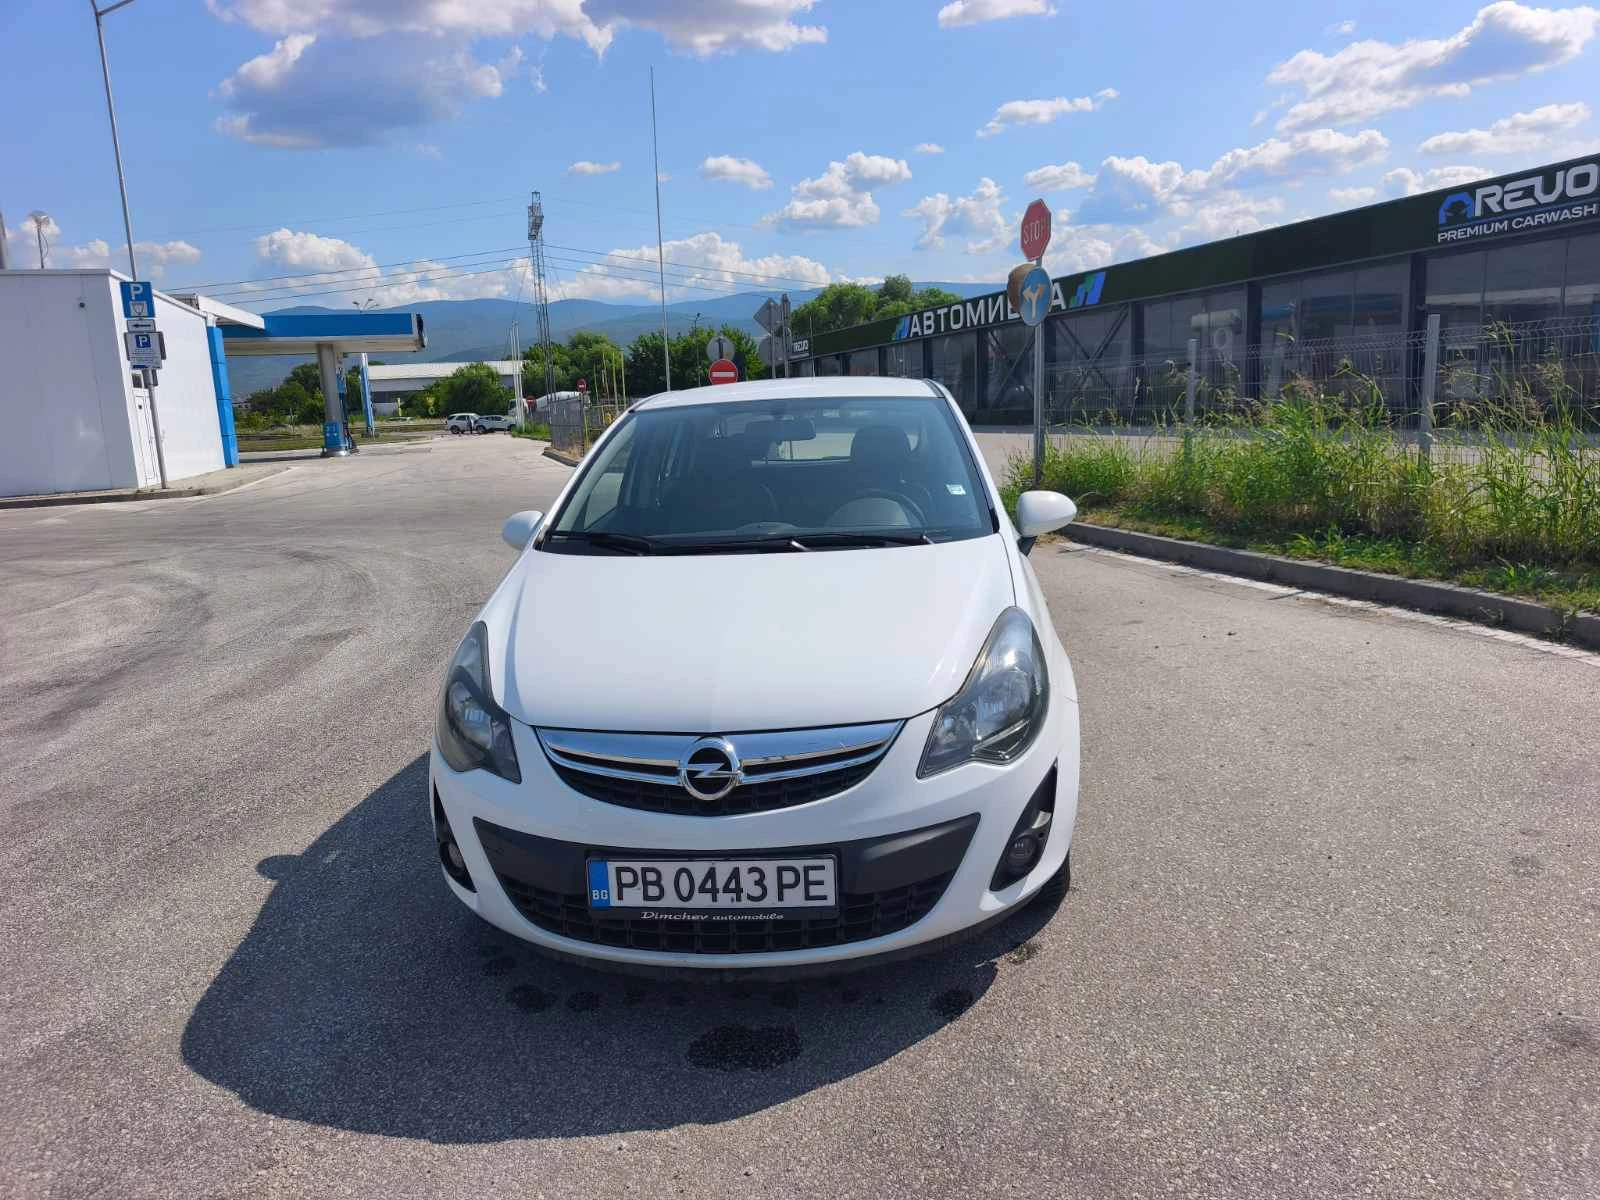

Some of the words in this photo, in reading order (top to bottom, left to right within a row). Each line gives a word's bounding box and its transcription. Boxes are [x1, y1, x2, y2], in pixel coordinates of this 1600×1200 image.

[1475, 163, 1599, 217] REVO
[1437, 220, 1508, 243] PREMIUM
[1511, 203, 1597, 229] CARWASH
[129, 284, 143, 300] P
[910, 282, 1067, 337] АВТОМИА
[139, 335, 148, 347] P
[592, 889, 608, 900] BG
[615, 867, 665, 902] PB
[673, 866, 768, 902] 0443
[776, 865, 828, 901] PE
[640, 911, 709, 921] Dimchev
